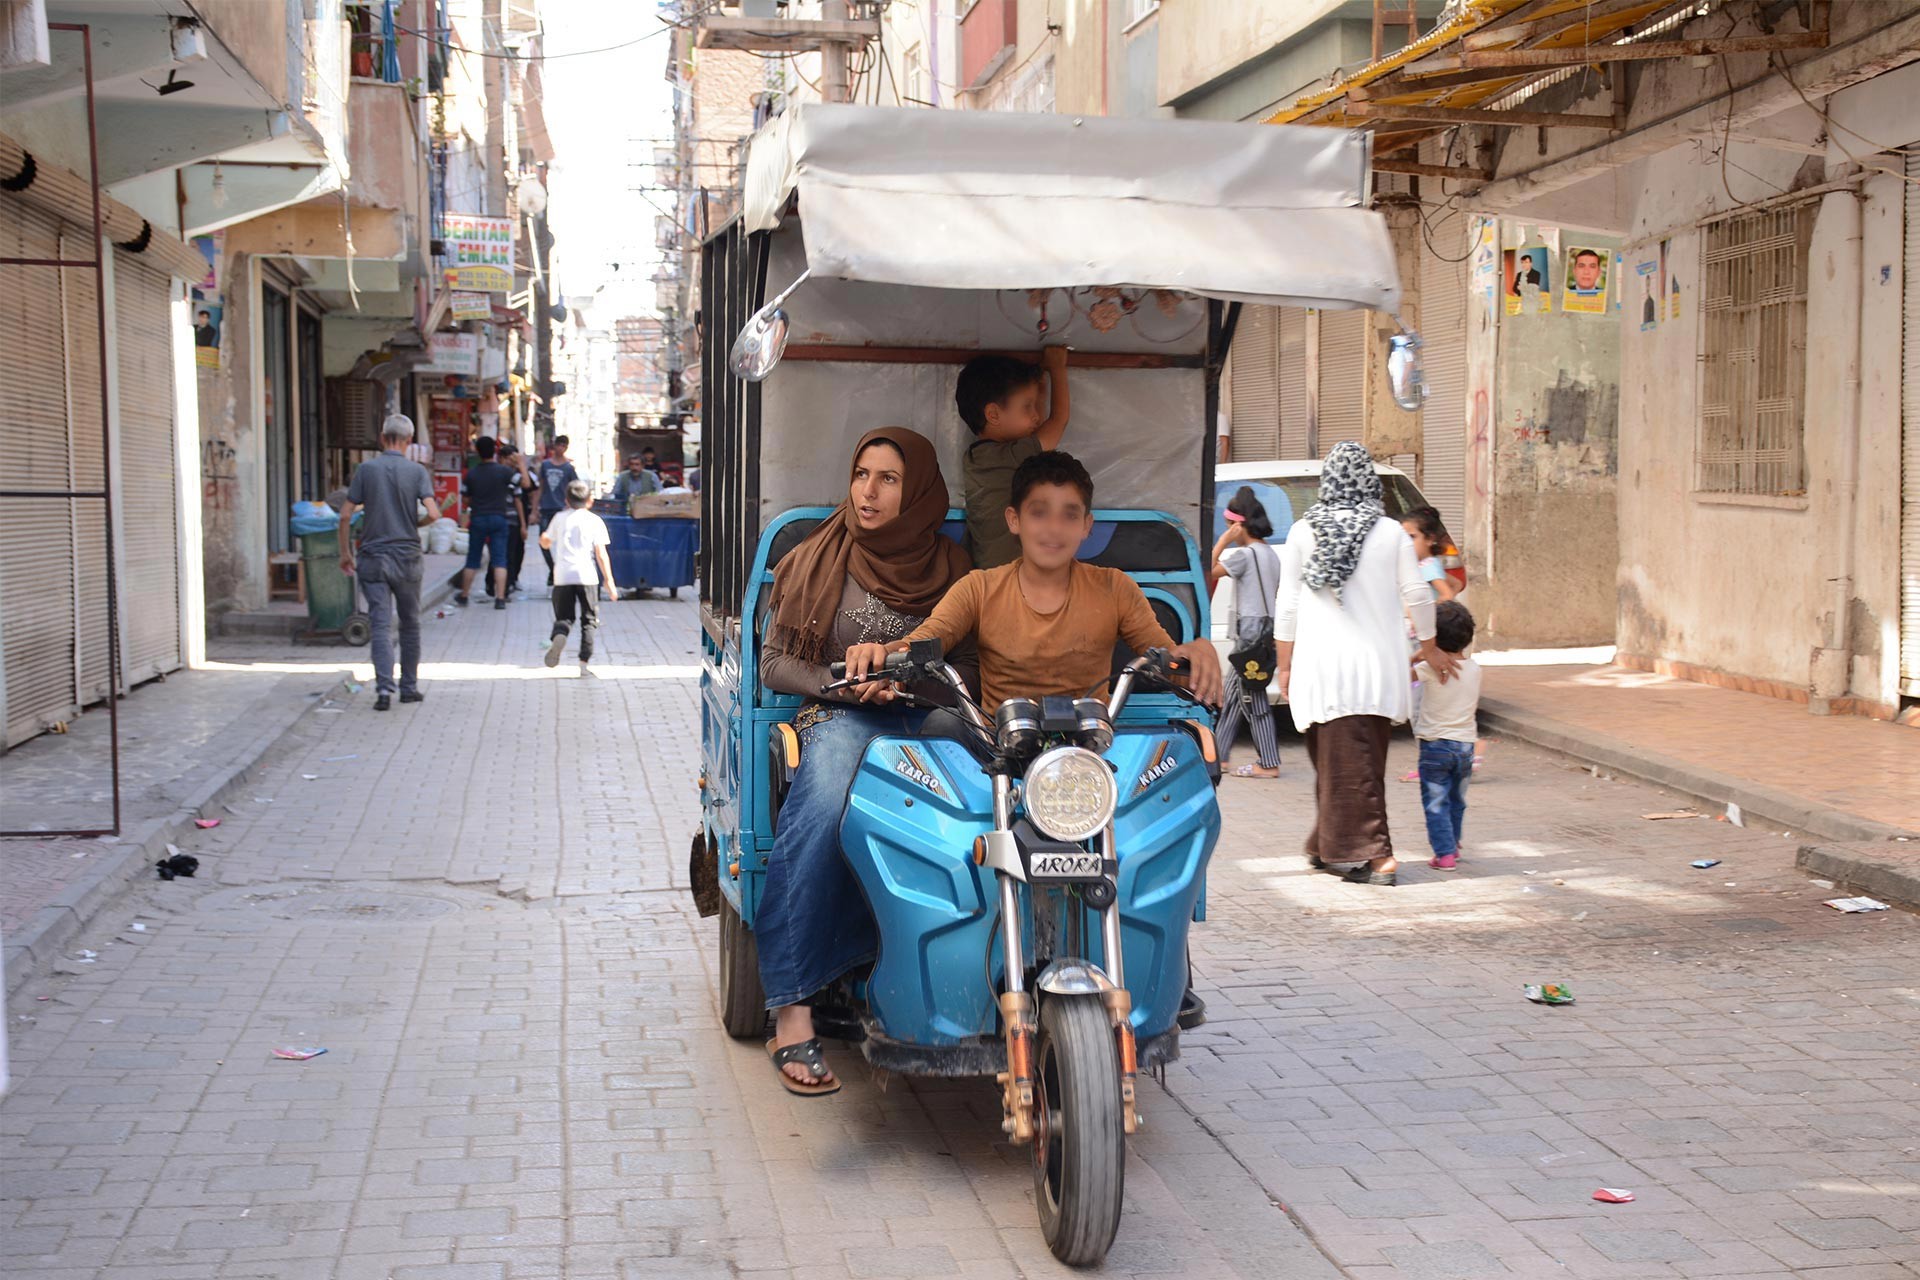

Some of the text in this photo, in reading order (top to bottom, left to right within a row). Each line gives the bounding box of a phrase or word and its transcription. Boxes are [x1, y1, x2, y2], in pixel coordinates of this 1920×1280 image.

[457, 242, 509, 265] EMLAK
[896, 760, 940, 789] KARGO
[1137, 755, 1178, 788] KARGO
[1034, 856, 1101, 874] ARORA
